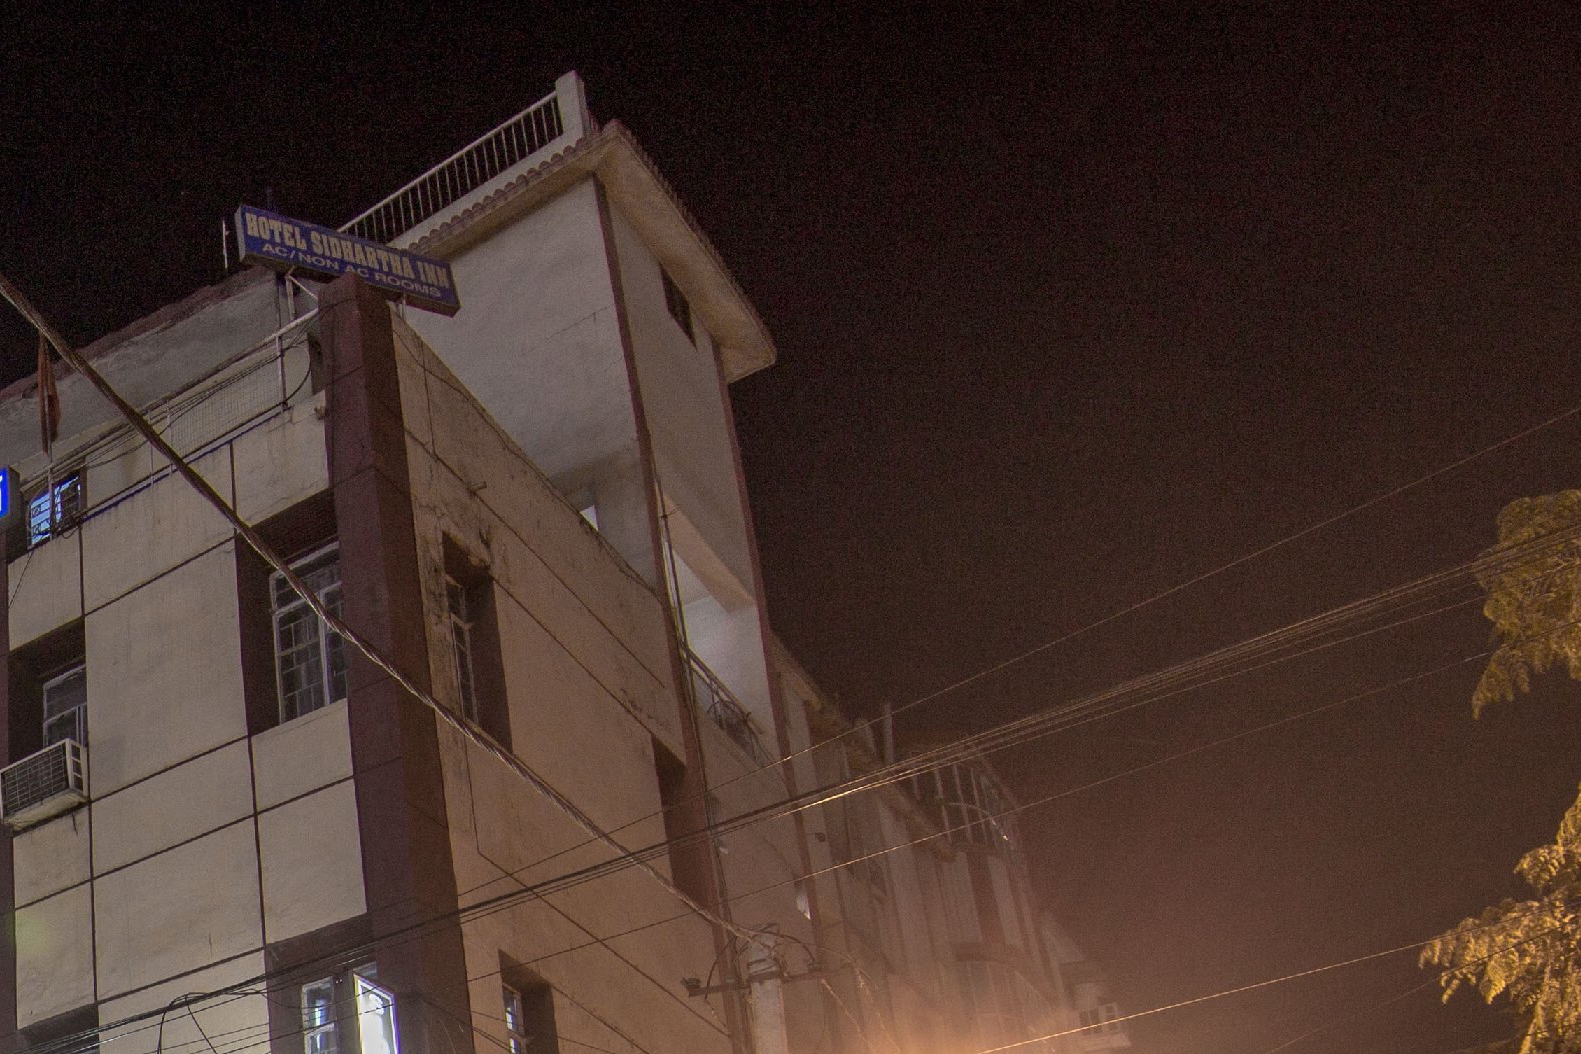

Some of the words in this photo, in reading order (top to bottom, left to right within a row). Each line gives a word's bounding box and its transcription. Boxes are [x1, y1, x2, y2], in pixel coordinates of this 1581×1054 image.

[244, 212, 307, 249] HOTEL
[310, 230, 416, 279] SIDHARTHA
[417, 259, 451, 289] INN
[344, 263, 369, 280] AC
[374, 270, 443, 299] ROOMS
